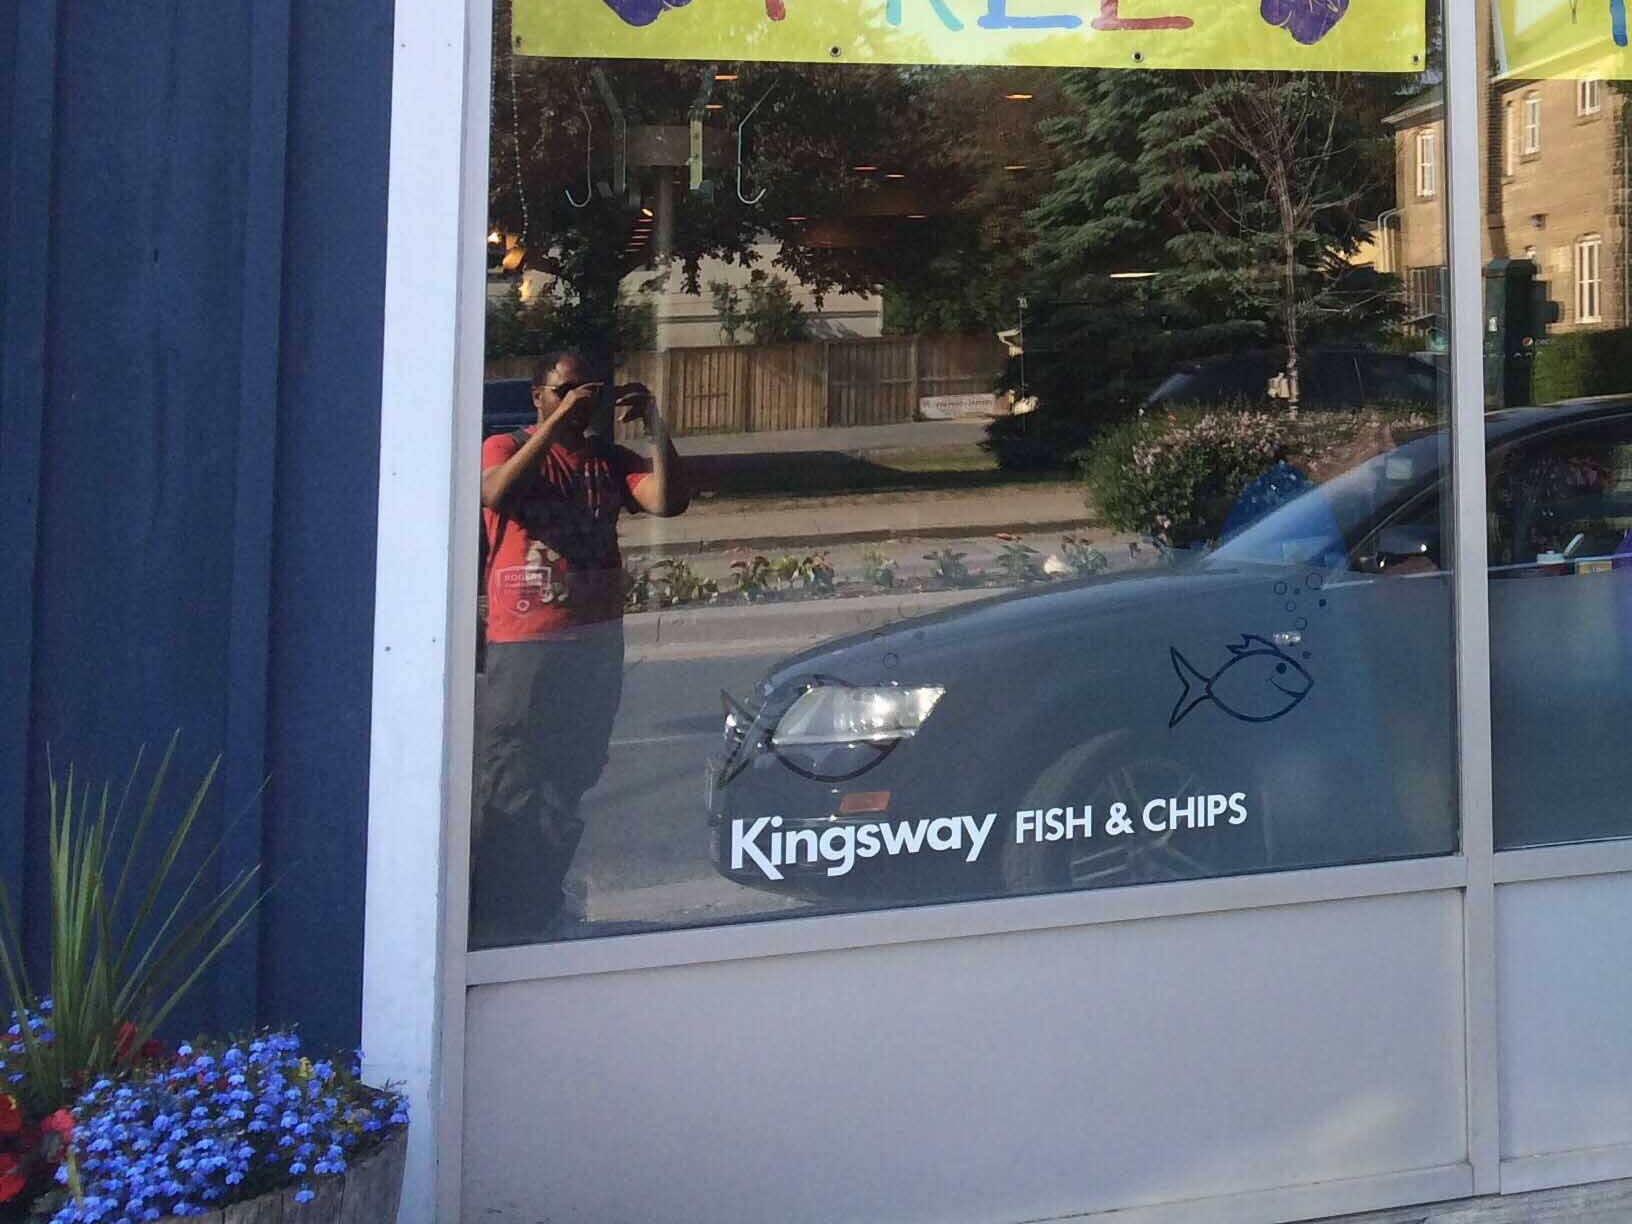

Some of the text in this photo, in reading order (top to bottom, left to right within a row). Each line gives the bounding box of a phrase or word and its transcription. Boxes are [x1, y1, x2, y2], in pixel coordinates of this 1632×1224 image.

[731, 792, 1247, 880] Kingsway FISH & CHIPS
